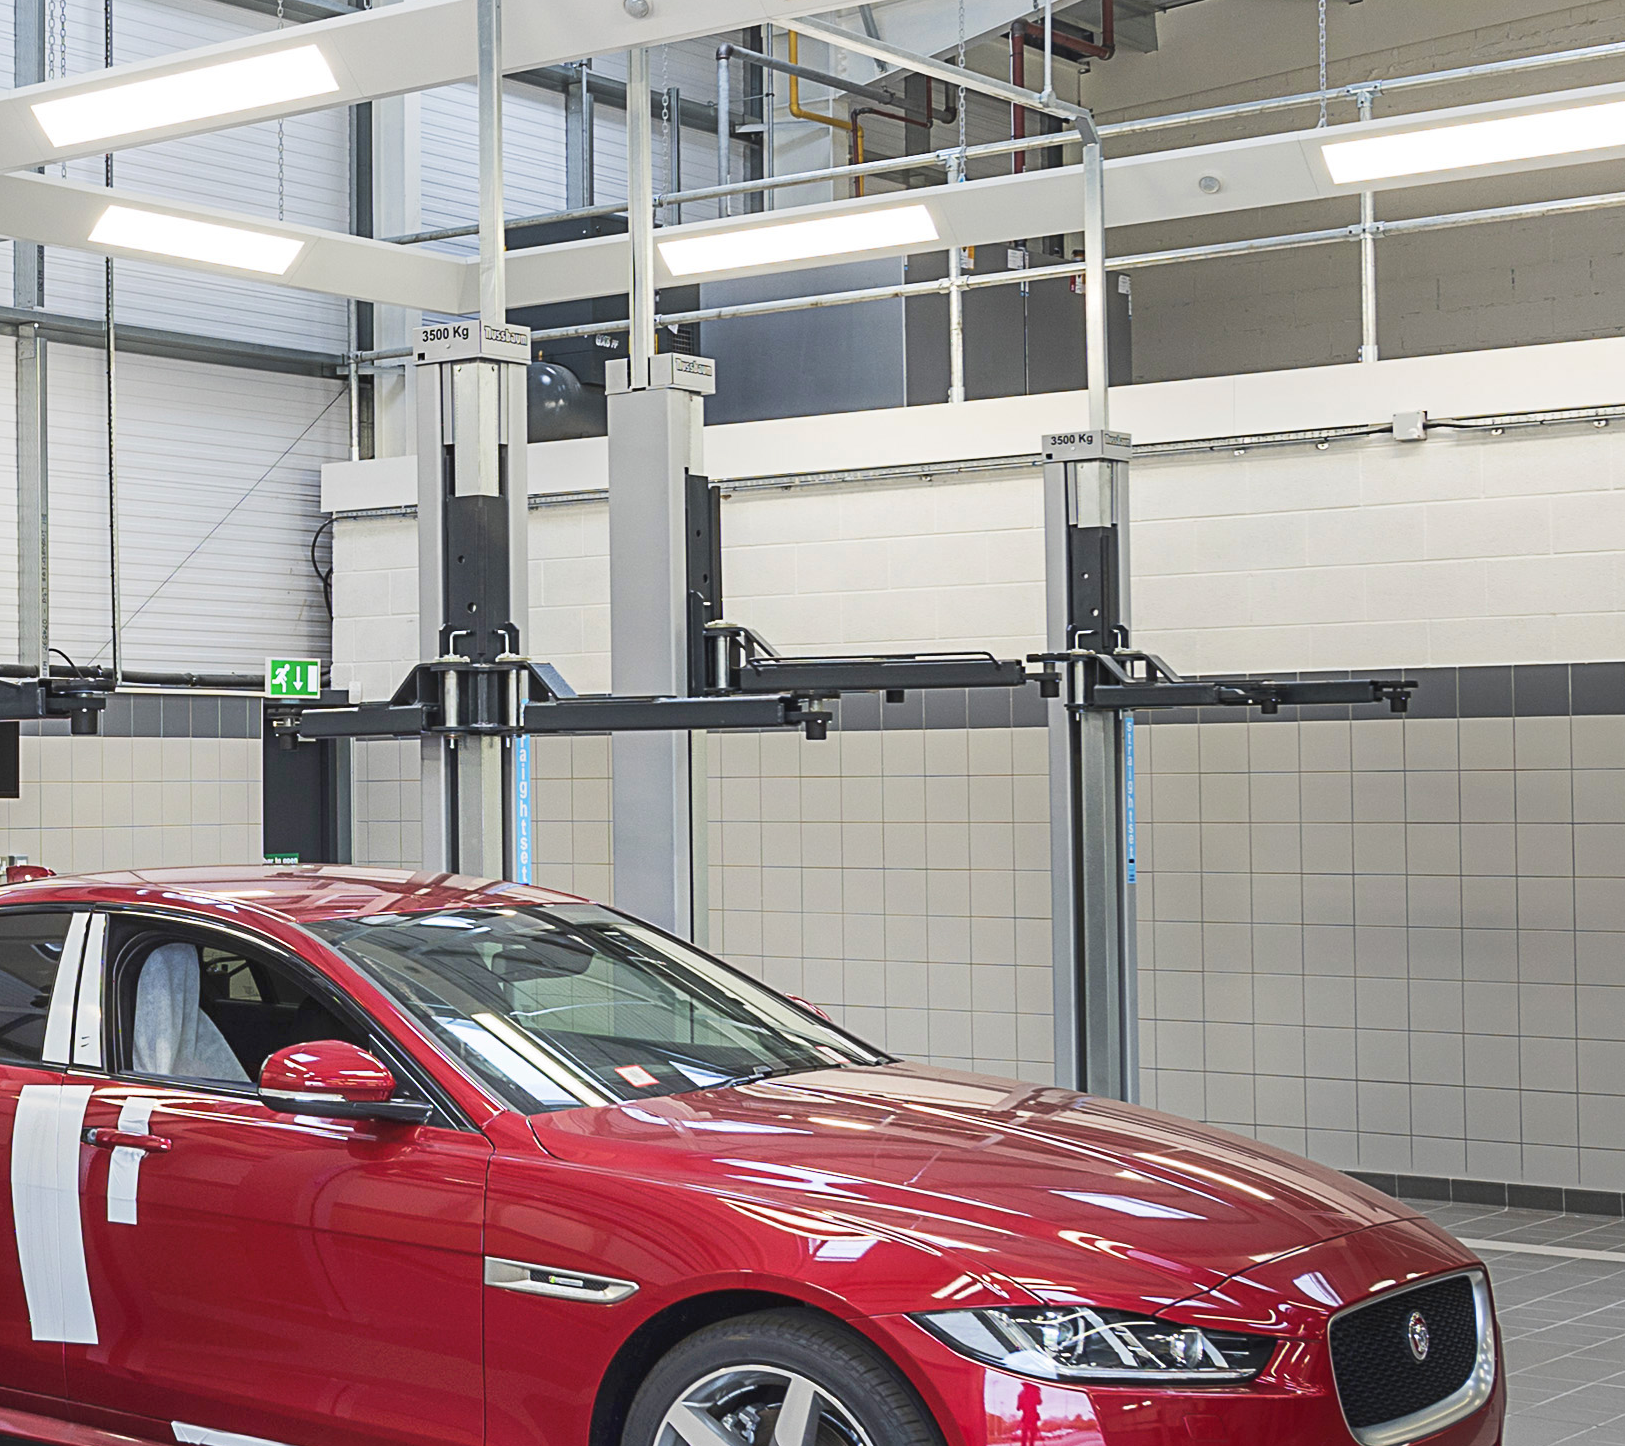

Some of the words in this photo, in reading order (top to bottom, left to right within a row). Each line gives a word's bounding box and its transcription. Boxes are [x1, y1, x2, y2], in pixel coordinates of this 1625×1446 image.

[422, 328, 449, 342] 3500
[453, 326, 469, 340] Kg
[1051, 435, 1075, 445] 3500
[1078, 434, 1093, 444] Kg
